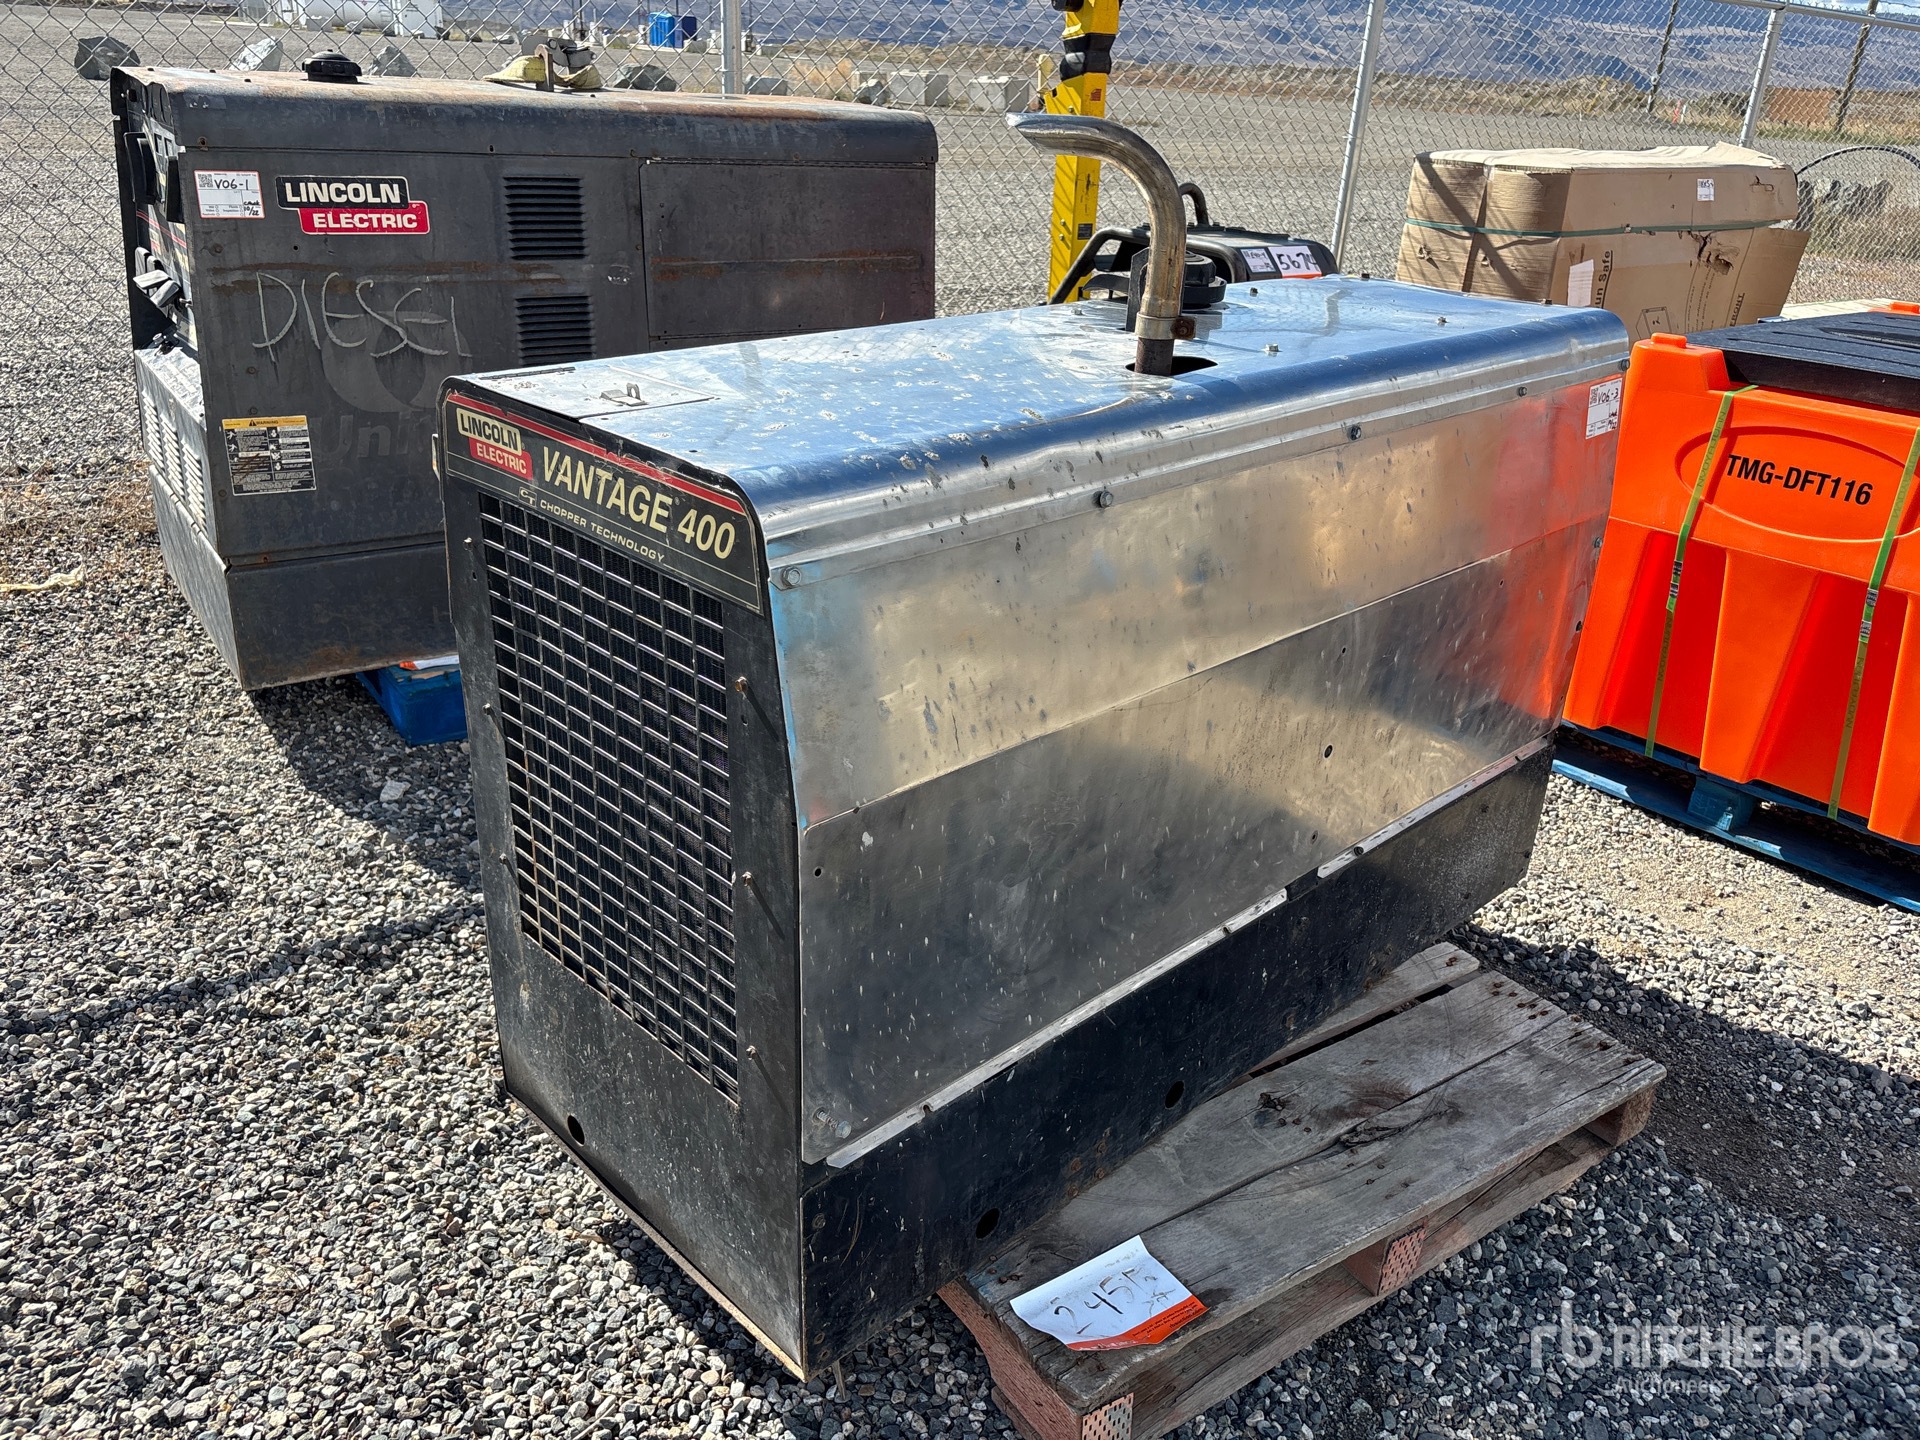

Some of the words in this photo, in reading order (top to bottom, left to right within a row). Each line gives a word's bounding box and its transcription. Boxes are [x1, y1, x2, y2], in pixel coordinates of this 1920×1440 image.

[213, 178, 249, 191] V06-1
[284, 182, 401, 204] LINCOLN
[312, 212, 418, 229] ELECTRIC
[1598, 250, 1611, 282] Safe
[252, 271, 473, 363] DIESEL
[460, 413, 518, 452] LINCOLN
[476, 442, 527, 475] ELECTRIC
[1726, 453, 1875, 506] TMG-DFT116
[543, 445, 673, 534] VANTAGE
[677, 508, 736, 560] 400
[539, 499, 588, 528] CHOPPER
[590, 521, 666, 563] TECHNOLOGY
